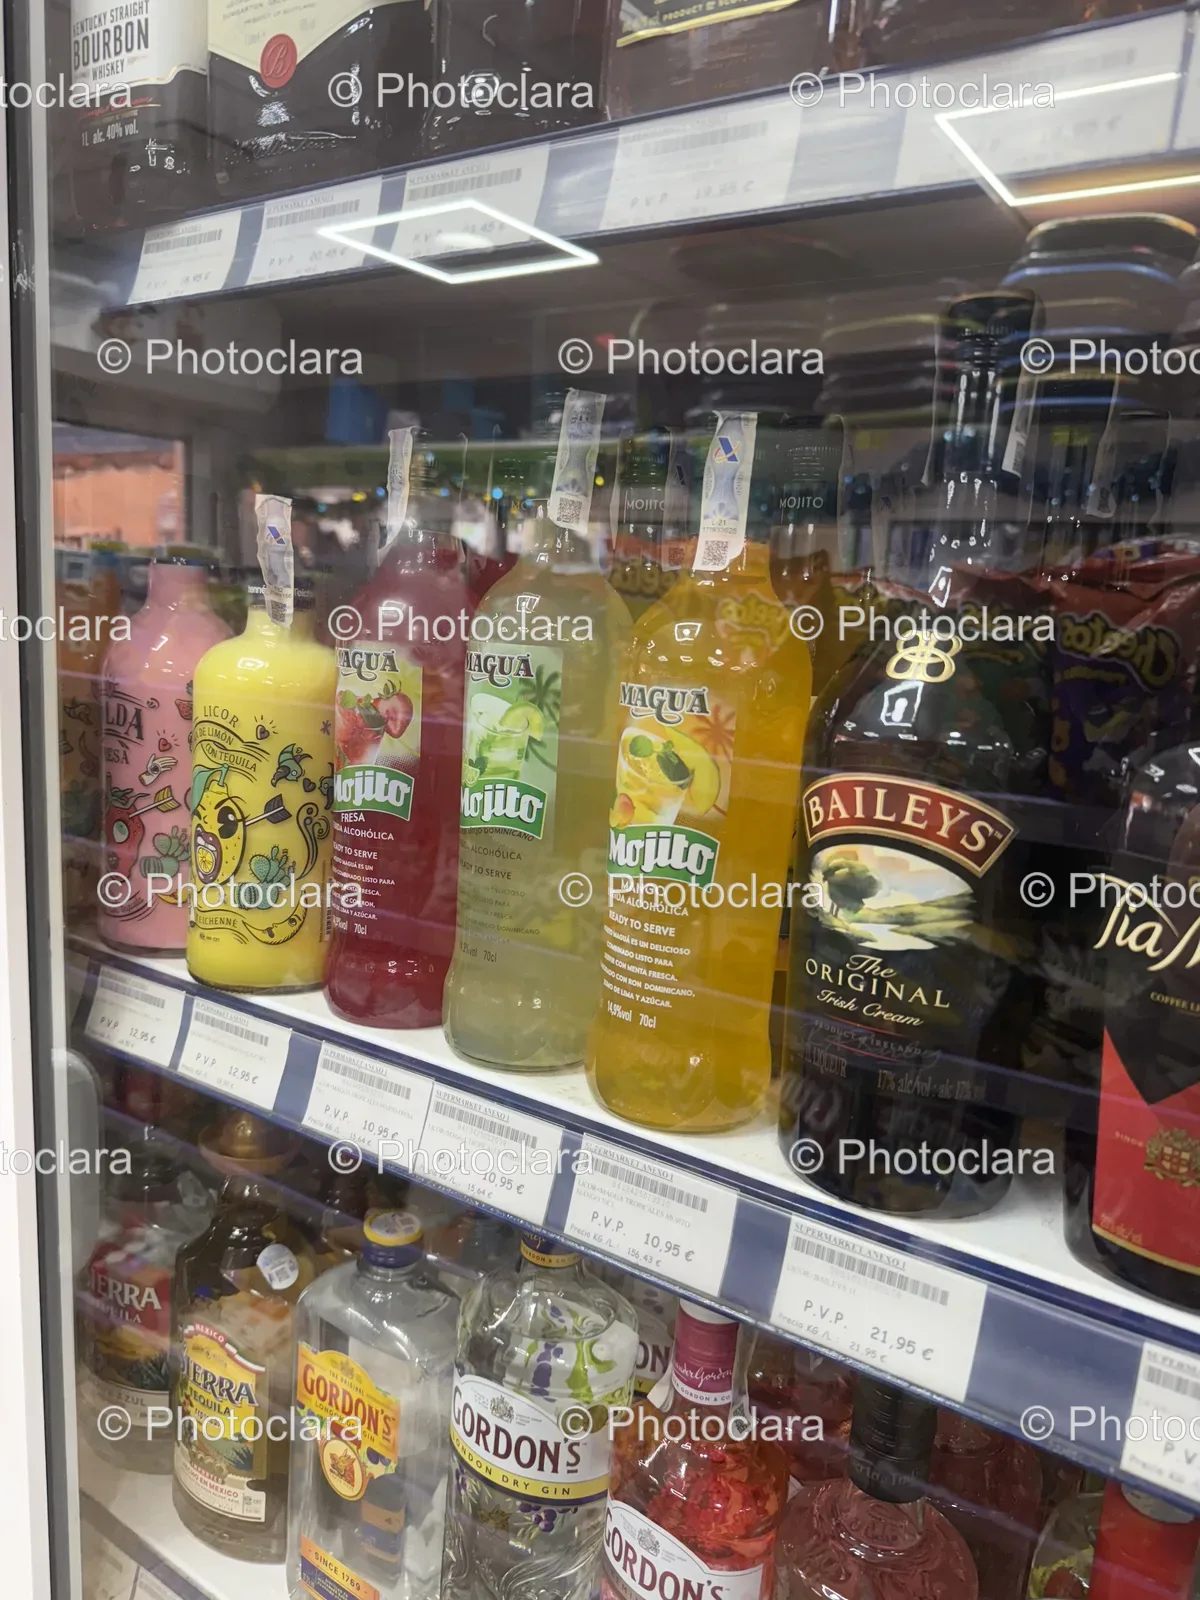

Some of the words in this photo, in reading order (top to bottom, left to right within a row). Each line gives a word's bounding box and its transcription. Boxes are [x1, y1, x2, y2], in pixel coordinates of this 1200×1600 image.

[73, 12, 107, 36] KENTUCKY
[110, 0, 149, 23] STRAIGHT
[74, 18, 149, 71] BOURBON
[92, 59, 125, 81] WHISKEY
[125, 119, 138, 134] vol.
[779, 496, 824, 510] MOJITO
[337, 648, 399, 681] AGUÁ
[203, 705, 239, 728] LICOR
[205, 743, 217, 759] CON
[219, 751, 257, 772] TEQUILA
[341, 812, 365, 822] FRESA
[808, 786, 995, 852] BAILEYS
[343, 826, 394, 840] ALCOHÓLICA
[345, 846, 352, 855] TO
[354, 848, 377, 860] SERVE
[471, 846, 522, 861] ALCOHÓLICA
[608, 829, 715, 876] Mojito
[362, 876, 378, 884] LISTO
[474, 865, 484, 875] TO
[486, 868, 512, 880] SERVE
[626, 898, 689, 917] ALCOHÓLICA
[354, 923, 367, 935] 70cl
[609, 910, 629, 927] READY
[630, 918, 641, 930] TO
[643, 923, 676, 937] SERVE
[483, 949, 497, 962] 70cl
[631, 937, 638, 946] ES
[639, 940, 649, 949] UN
[650, 942, 691, 955] DELICIOSO
[615, 959, 627, 970] CON
[627, 964, 648, 976] MENTA
[648, 969, 678, 982] FRESCA.
[635, 953, 653, 963] LISTO
[654, 957, 674, 967] PARA
[846, 953, 898, 979] The
[616, 973, 628, 984] CON
[628, 978, 642, 989] RON
[805, 958, 950, 1008] ORIGINAL
[614, 986, 620, 995] DE
[621, 989, 634, 1000] LIMA
[640, 995, 672, 1008] AZÚCAR.
[817, 989, 859, 1012] Irish
[863, 1002, 924, 1026] Cream
[639, 1013, 656, 1028] 70cl
[228, 1065, 251, 1082] 12,95
[252, 1075, 258, 1084] €
[435, 1090, 482, 1113] SUPERMARKET
[363, 1120, 390, 1139] 10,95
[585, 1143, 642, 1170] SUPERMARKET
[467, 1183, 486, 1196] 15,64
[482, 1172, 513, 1191] 10,95
[516, 1184, 525, 1195] €
[570, 1223, 591, 1238] Precio
[590, 1211, 626, 1236] P.V.P.
[644, 1232, 681, 1257] 10,95
[685, 1250, 695, 1262] €
[794, 1222, 863, 1256] SUPERMARKET
[866, 1249, 900, 1268] ANEXO
[778, 1312, 803, 1329] Precio
[804, 1300, 847, 1329] P.V.P.
[870, 1326, 917, 1355] 21,95
[922, 1347, 934, 1361] €
[340, 1376, 365, 1396] ORIGINAL
[681, 1386, 710, 1402] GORDON
[189, 1387, 231, 1416] TEQUILA
[303, 1363, 392, 1443] GORDON'S
[363, 1430, 375, 1443] GIN
[453, 1385, 581, 1474] GORDON'S
[452, 1432, 493, 1475] LONDON
[502, 1475, 530, 1490] DRY
[209, 1483, 239, 1498] MEXICO
[314, 1552, 338, 1575] SINCE
[342, 1572, 360, 1591] 1769
